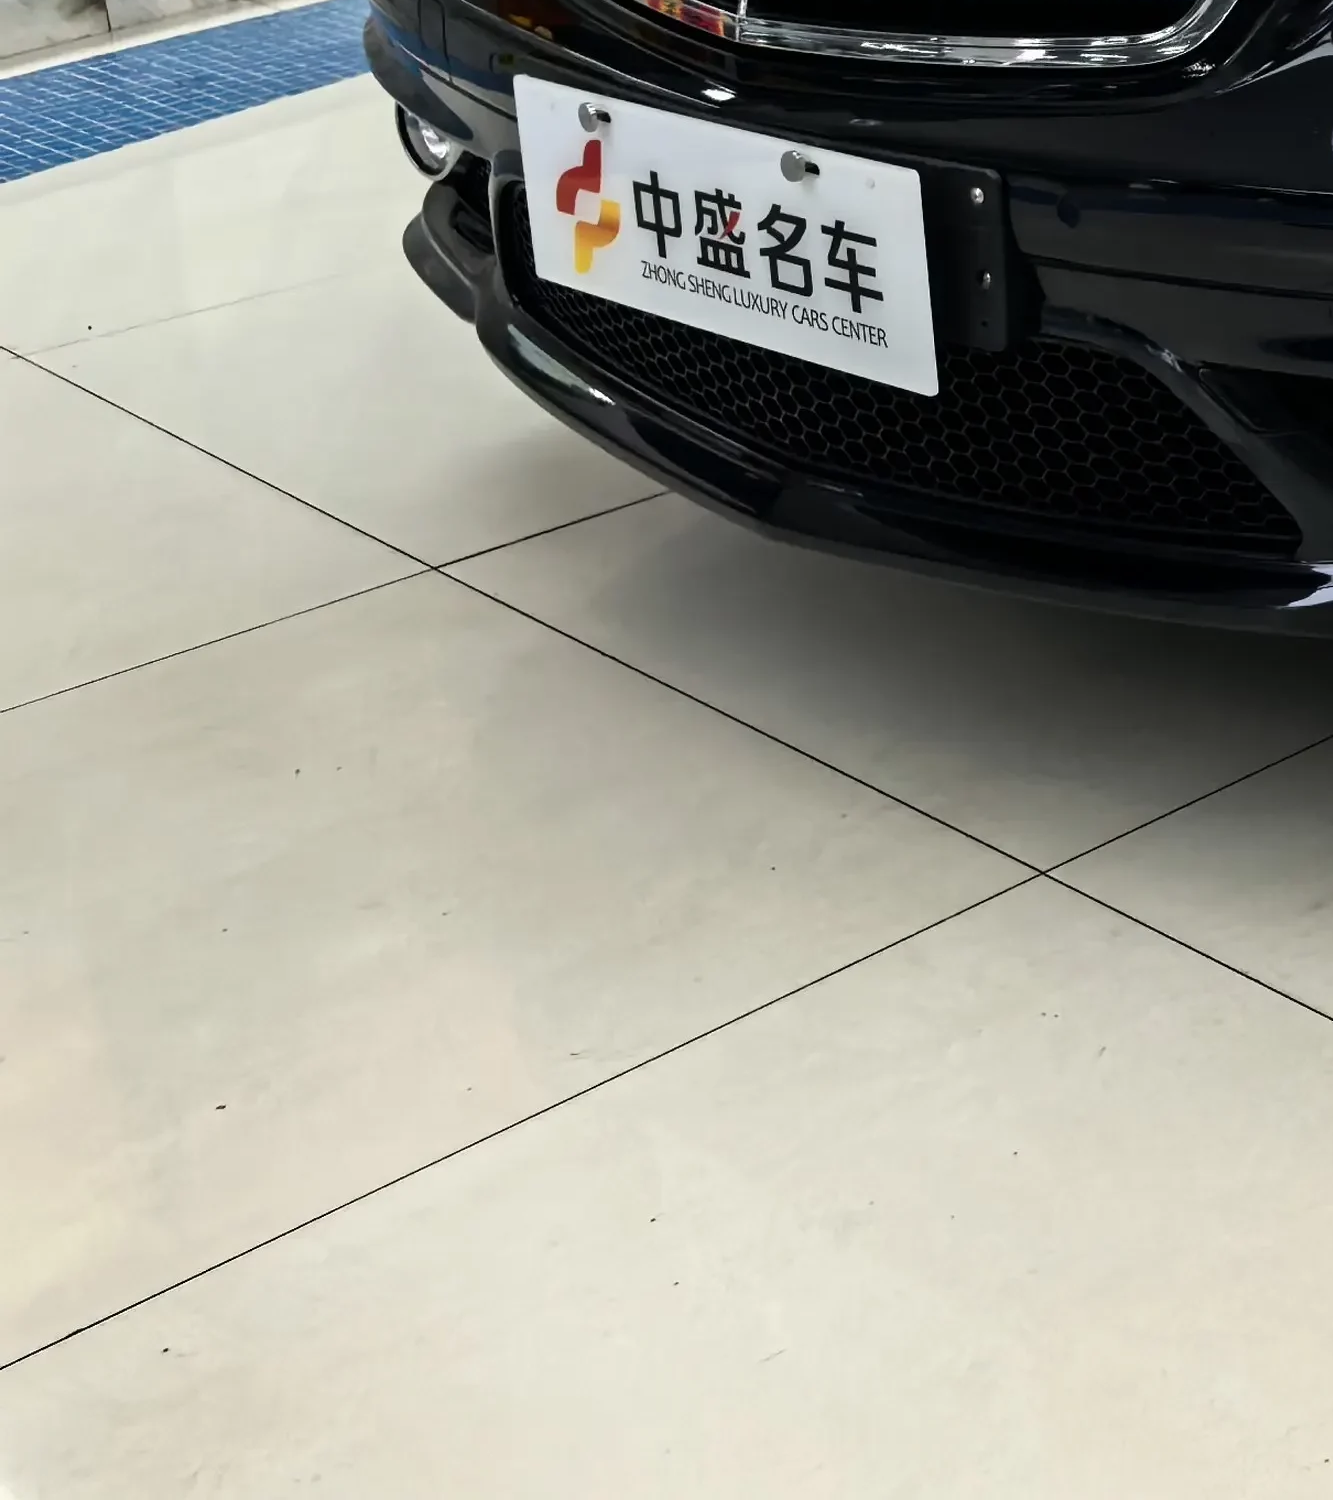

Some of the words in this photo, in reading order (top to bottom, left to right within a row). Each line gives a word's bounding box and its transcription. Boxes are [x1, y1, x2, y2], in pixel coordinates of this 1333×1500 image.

[633, 170, 885, 314] 中盛名车
[640, 260, 686, 291] ZHONG
[688, 273, 732, 303] SHENG
[733, 287, 788, 321] LUXURY
[792, 306, 828, 332] CARS
[831, 315, 889, 349] CENTER
